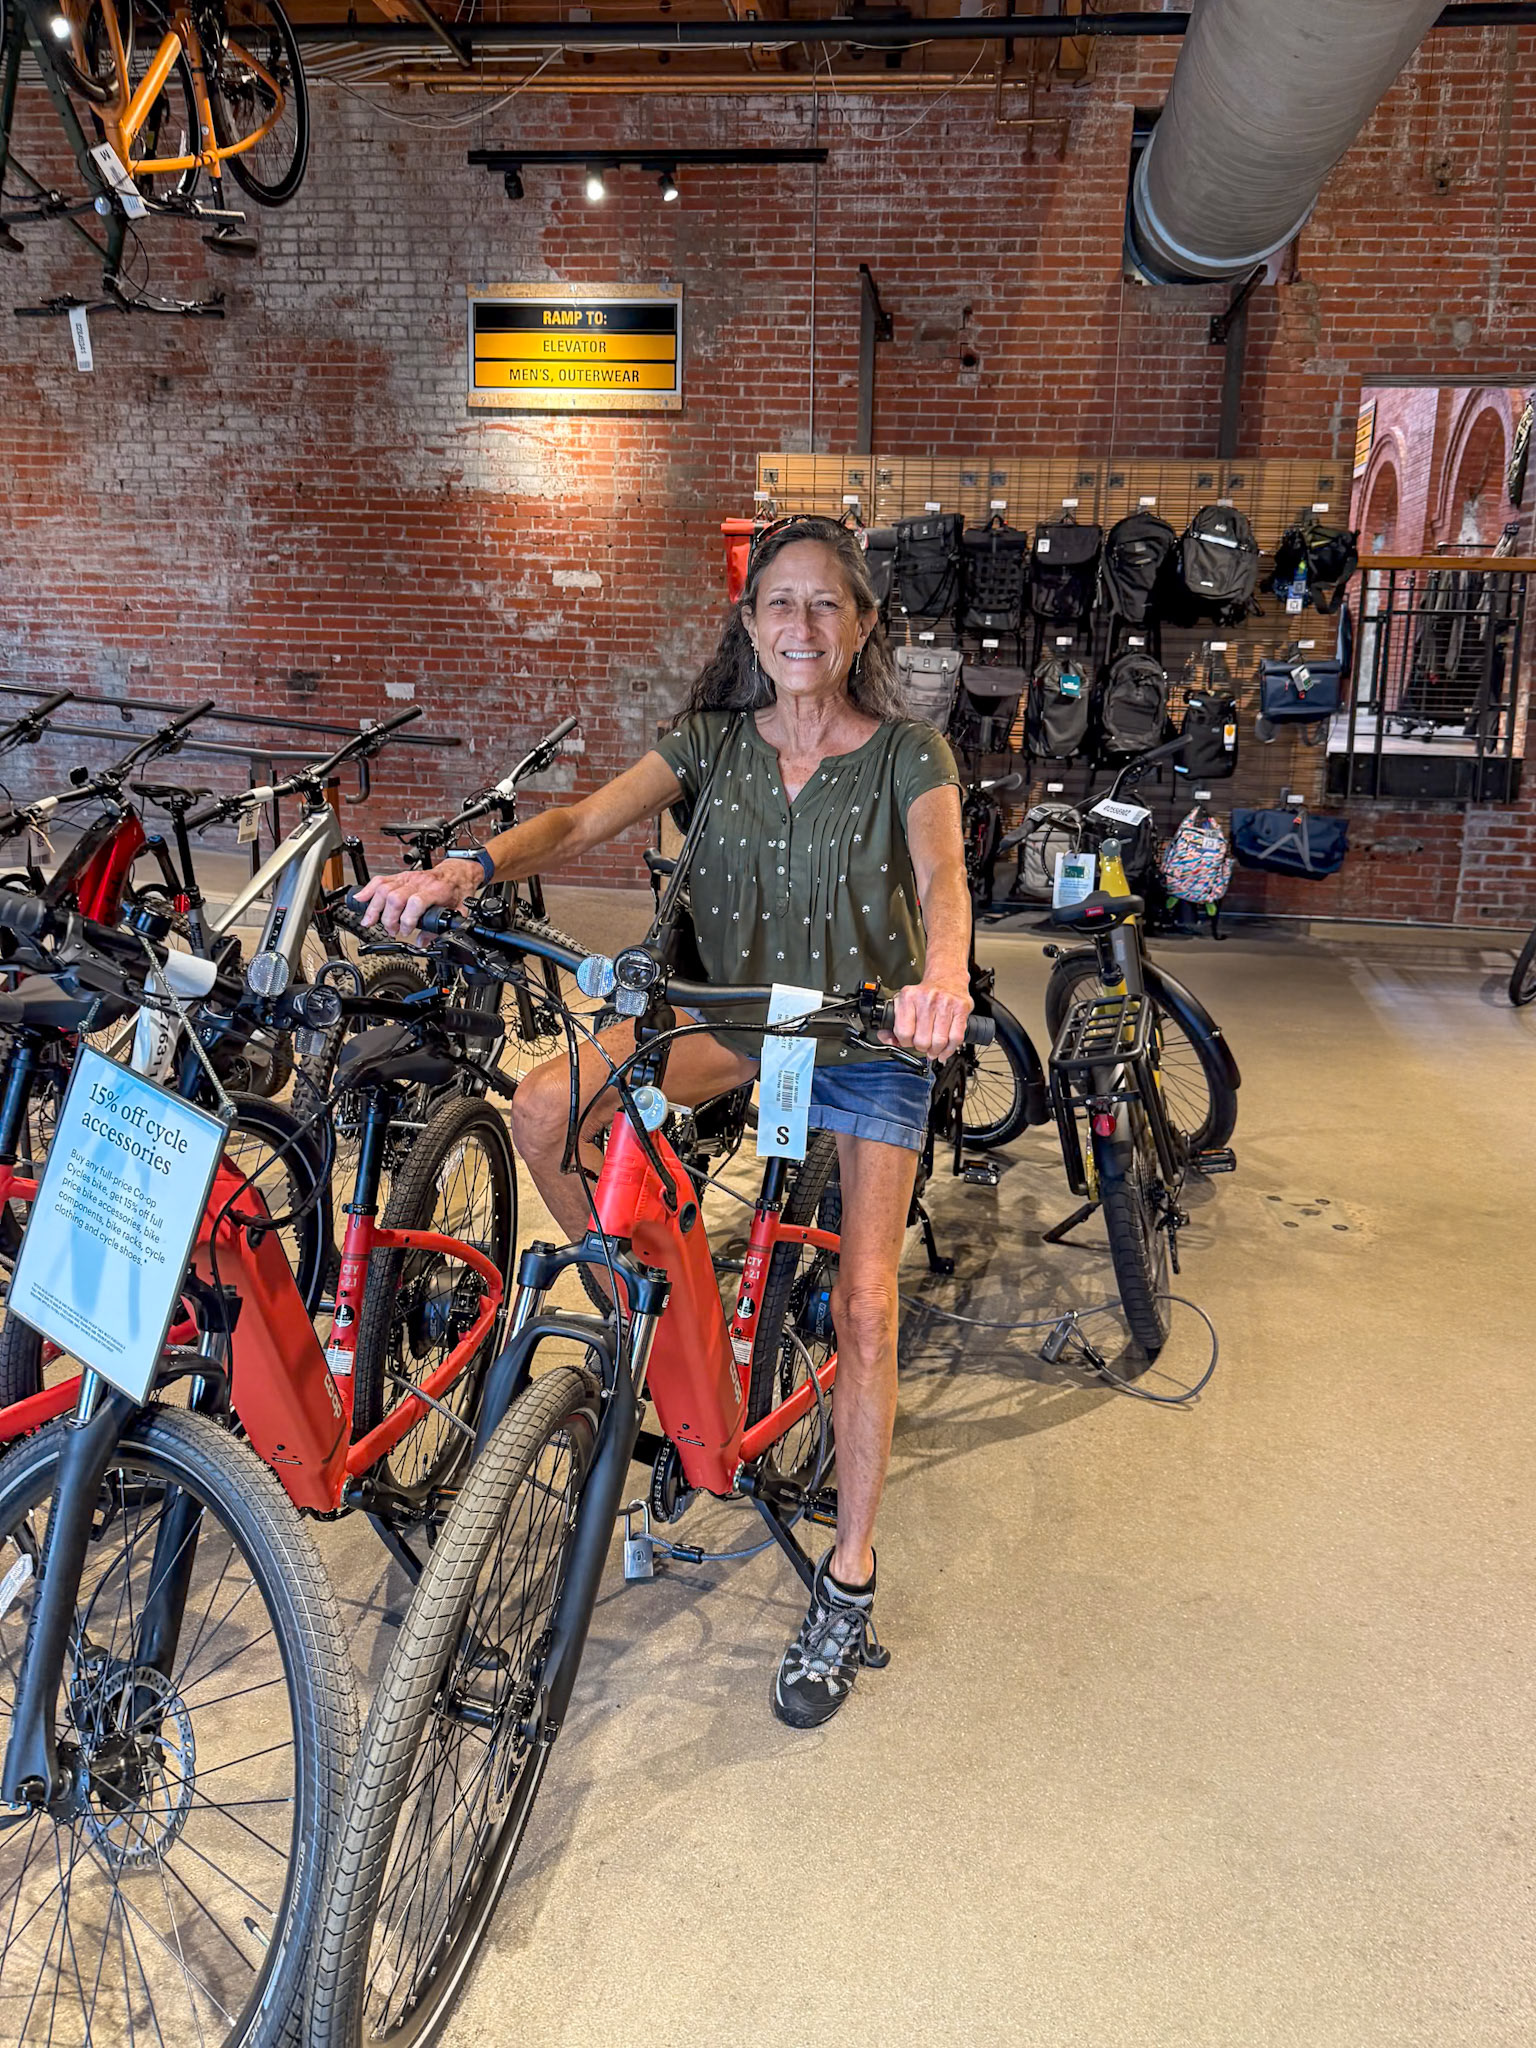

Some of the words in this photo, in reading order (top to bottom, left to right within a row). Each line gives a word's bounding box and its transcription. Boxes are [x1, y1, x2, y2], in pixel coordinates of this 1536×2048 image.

[542, 311, 582, 326] RAMP
[586, 311, 608, 326] TO:
[543, 339, 607, 353] ELEVATOR
[509, 368, 554, 384] MEN'S,
[558, 368, 640, 383] OUTERWEAR
[89, 1083, 120, 1113] 15%
[121, 1105, 148, 1129] off
[146, 1119, 188, 1154] cycle
[776, 1126, 790, 1146] S
[82, 1112, 171, 1175] accessories
[67, 1162, 91, 1184] Cycles
[92, 1177, 108, 1196] bike,
[109, 1191, 123, 1204] get
[124, 1198, 138, 1213] 15%
[138, 1209, 150, 1220] off
[150, 1214, 164, 1229] full
[70, 1148, 85, 1165] Buy
[85, 1160, 99, 1174] any
[99, 1166, 132, 1192] full-price
[133, 1188, 157, 1209] Co-op
[55, 1203, 84, 1228] clothing
[84, 1222, 99, 1237] and
[99, 1232, 119, 1250] cycle
[58, 1190, 104, 1226] components,
[106, 1218, 122, 1235] bike
[122, 1231, 144, 1251] racks,
[145, 1246, 166, 1264] cycle
[62, 1177, 82, 1193] price
[82, 1187, 97, 1204] bike
[98, 1199, 142, 1234] accessories,
[144, 1226, 160, 1244] bike
[342, 1263, 359, 1274] CTY
[747, 1255, 763, 1267] CTY
